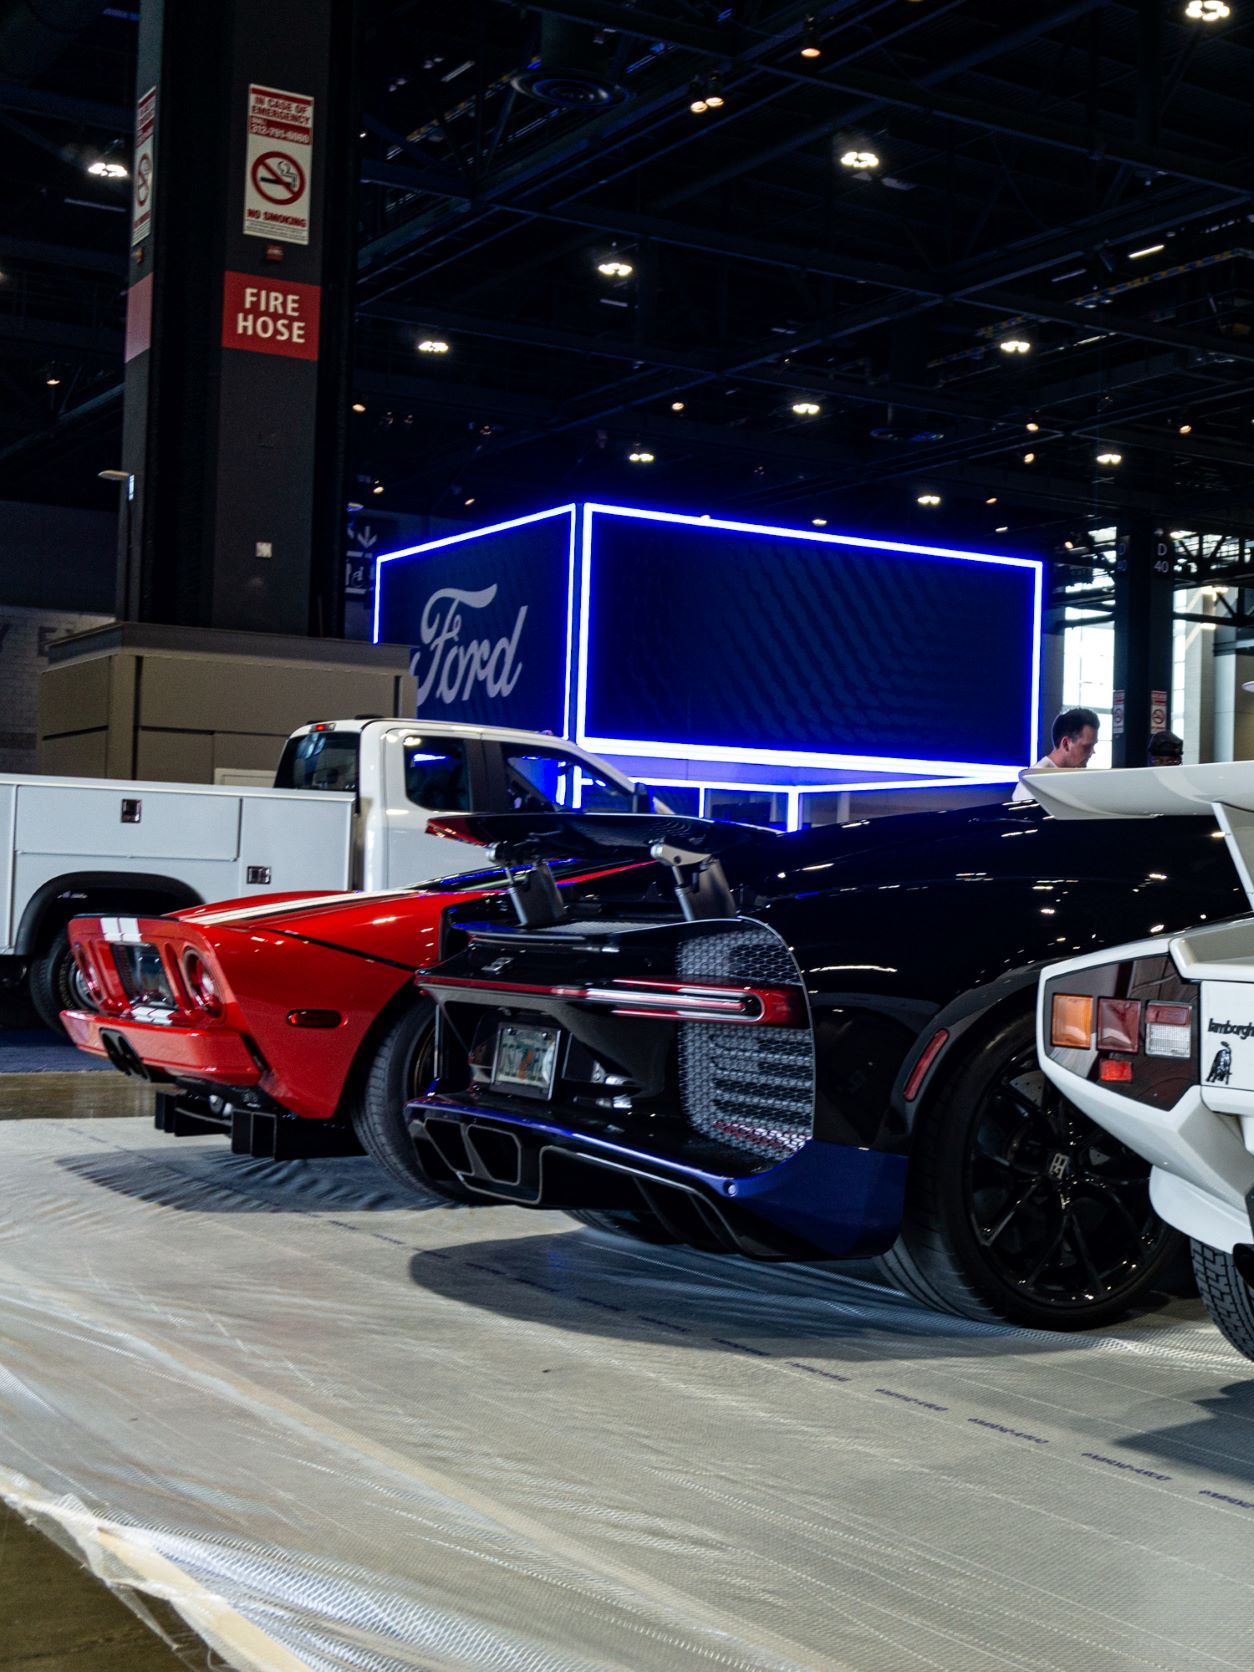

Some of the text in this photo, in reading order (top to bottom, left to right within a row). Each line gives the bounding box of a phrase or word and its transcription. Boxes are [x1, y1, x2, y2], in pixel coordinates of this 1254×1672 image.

[252, 105, 311, 125] EMERGENCY
[248, 208, 307, 228] NO SMOKING
[244, 287, 300, 316] FIRE
[237, 312, 305, 344] HOSE
[1157, 542, 1168, 556] D
[1154, 560, 1169, 573] 40
[410, 583, 528, 707] Ford
